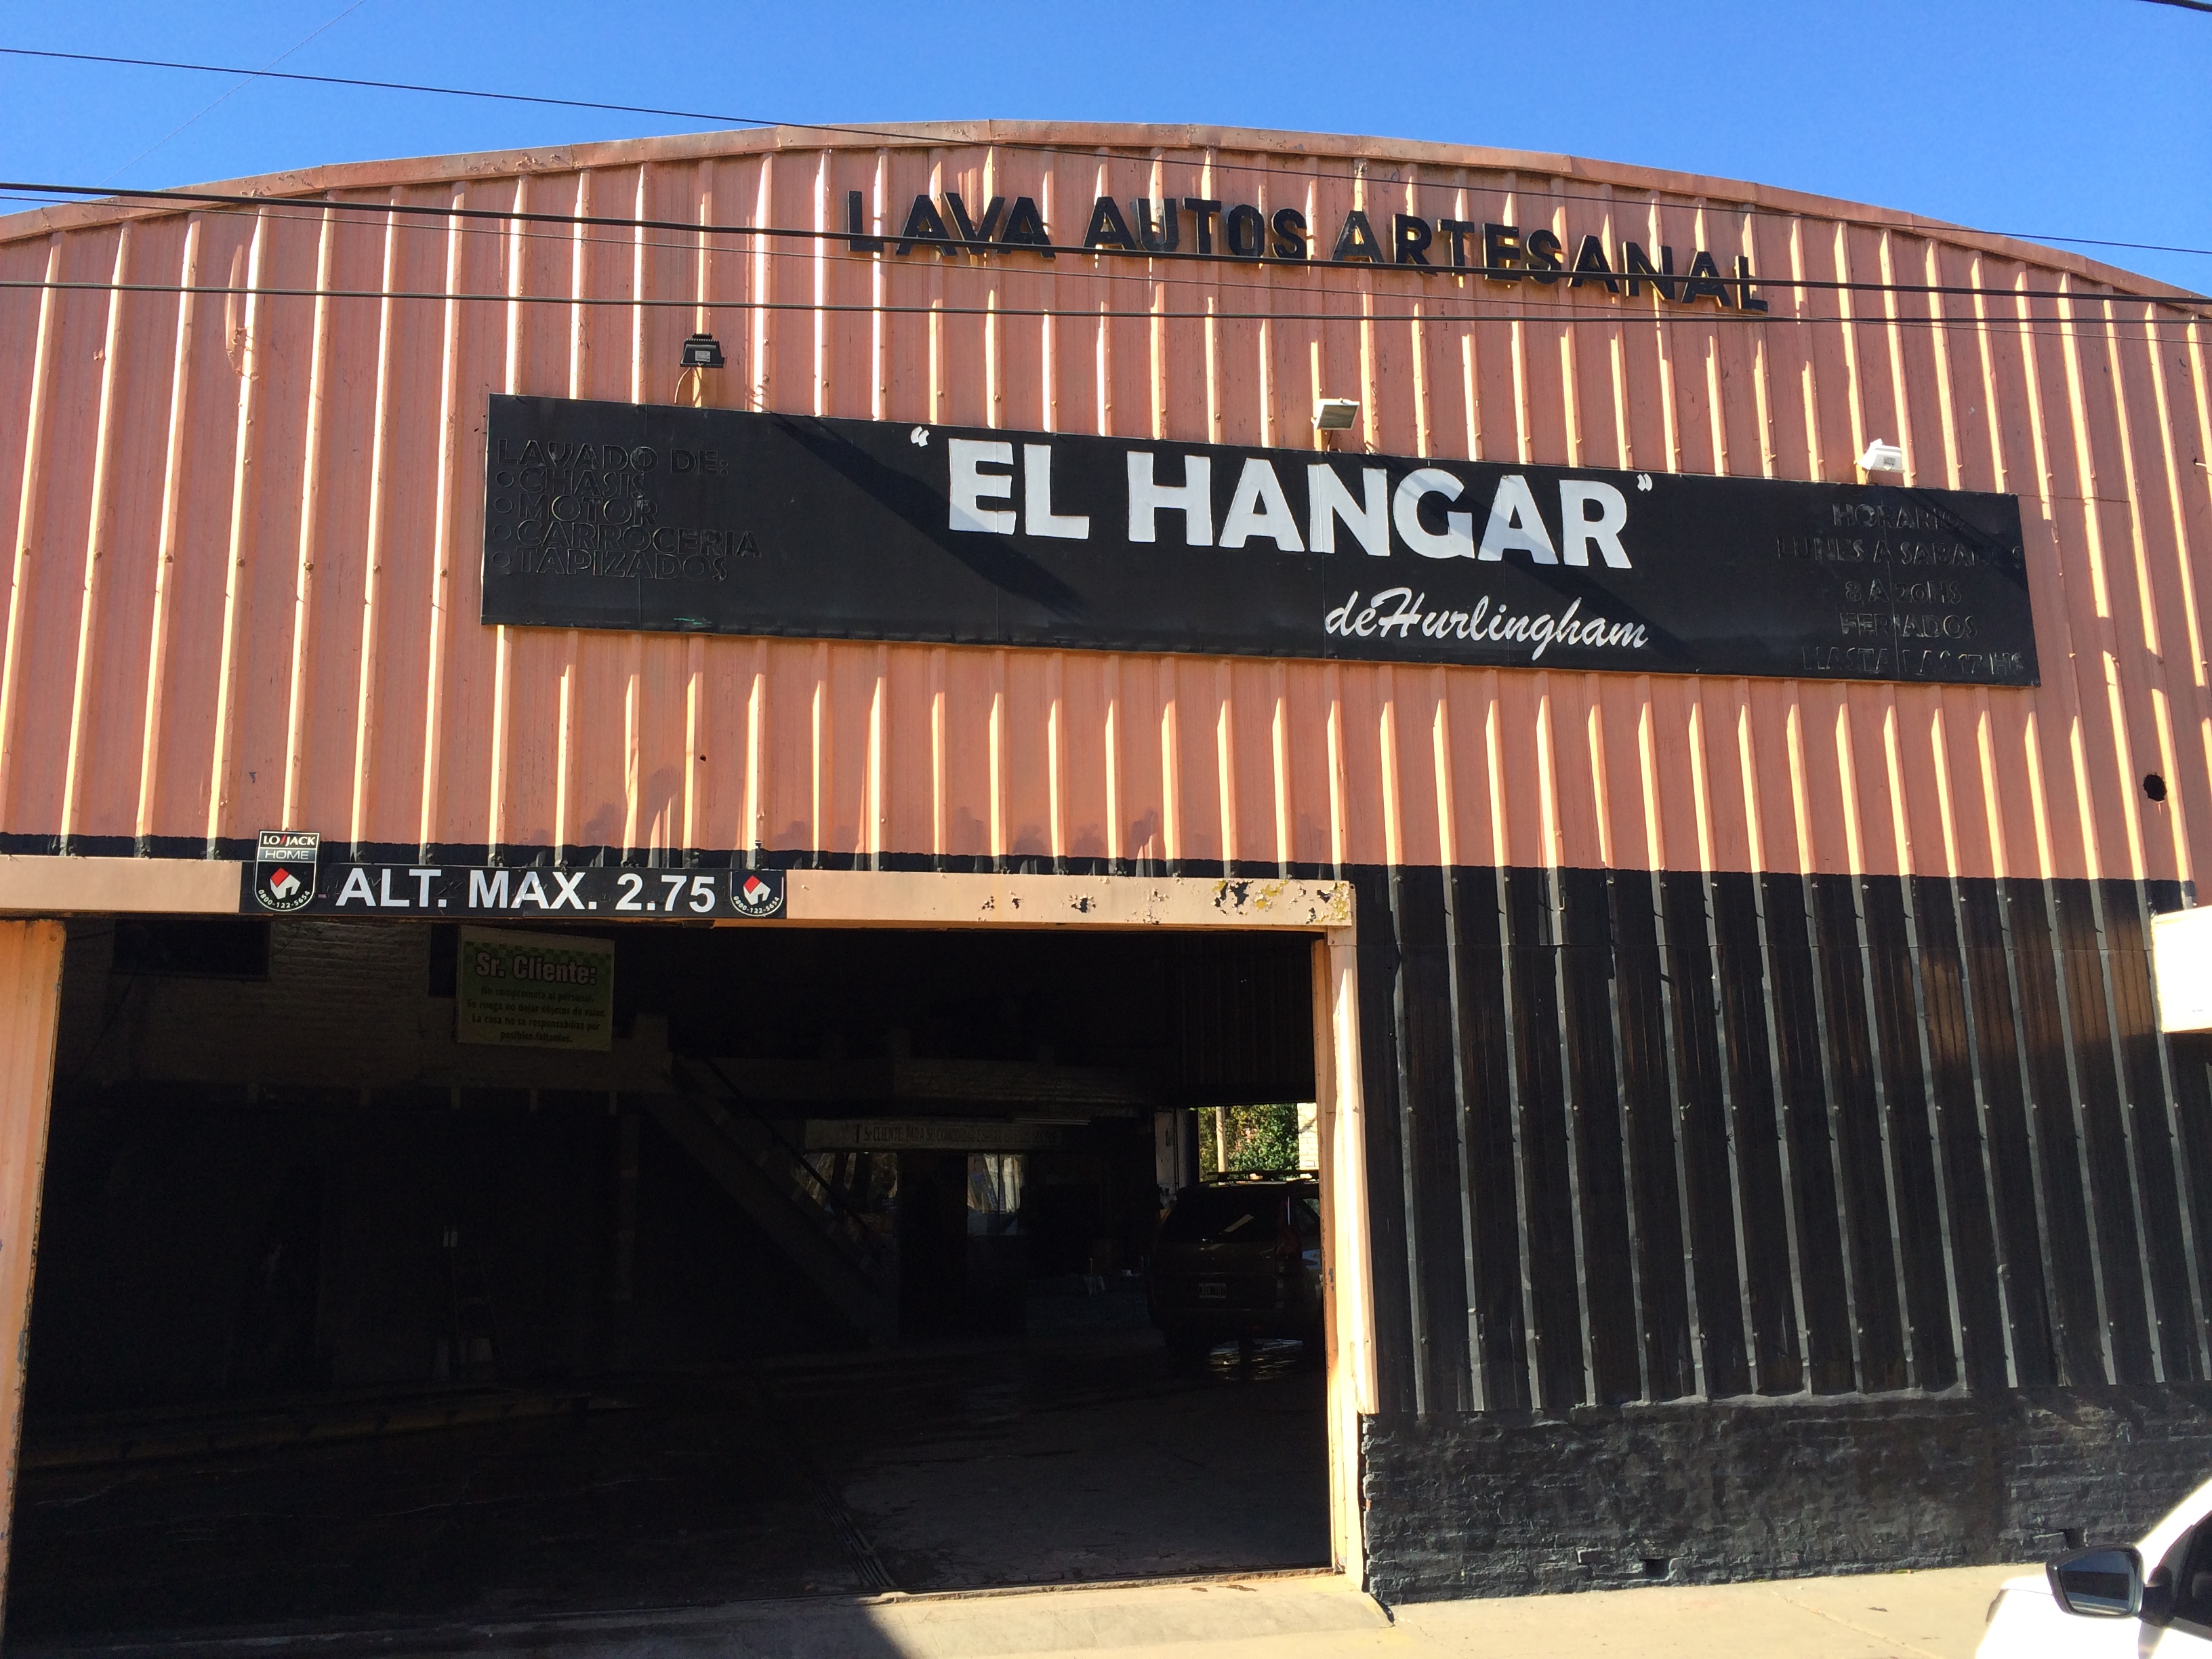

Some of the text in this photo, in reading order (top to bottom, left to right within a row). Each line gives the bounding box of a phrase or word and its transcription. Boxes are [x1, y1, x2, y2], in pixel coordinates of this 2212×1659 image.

[846, 190, 1769, 312] LAVA AUTOS ARTESANAL
[497, 438, 659, 473] LAVADO
[519, 466, 645, 499] CHASIS
[518, 493, 659, 526] MOTOR
[516, 519, 763, 558] CARROCERIA
[1776, 535, 1864, 563] LUNES
[1873, 539, 1895, 564] A
[516, 546, 729, 583] TAPIZADOS
[1845, 581, 1862, 602] 8
[1868, 578, 1890, 602] A
[1839, 612, 1978, 640] FERIADOS
[264, 849, 310, 860] HOME
[258, 889, 311, 909] 0800-122-5654
[335, 867, 717, 914] ALT. MAX. 2.75
[476, 951, 598, 985] Sr. Cliente:
[467, 999, 477, 1008] Se
[479, 1002, 503, 1012] ruega
[518, 1002, 539, 1015] dejar
[541, 1004, 571, 1017] objetos
[573, 1006, 583, 1015] de
[480, 986, 493, 996] No
[548, 991, 556, 1000] al
[472, 1014, 482, 1023] La
[529, 1019, 584, 1030] responsabiliza
[587, 1022, 600, 1031] por
